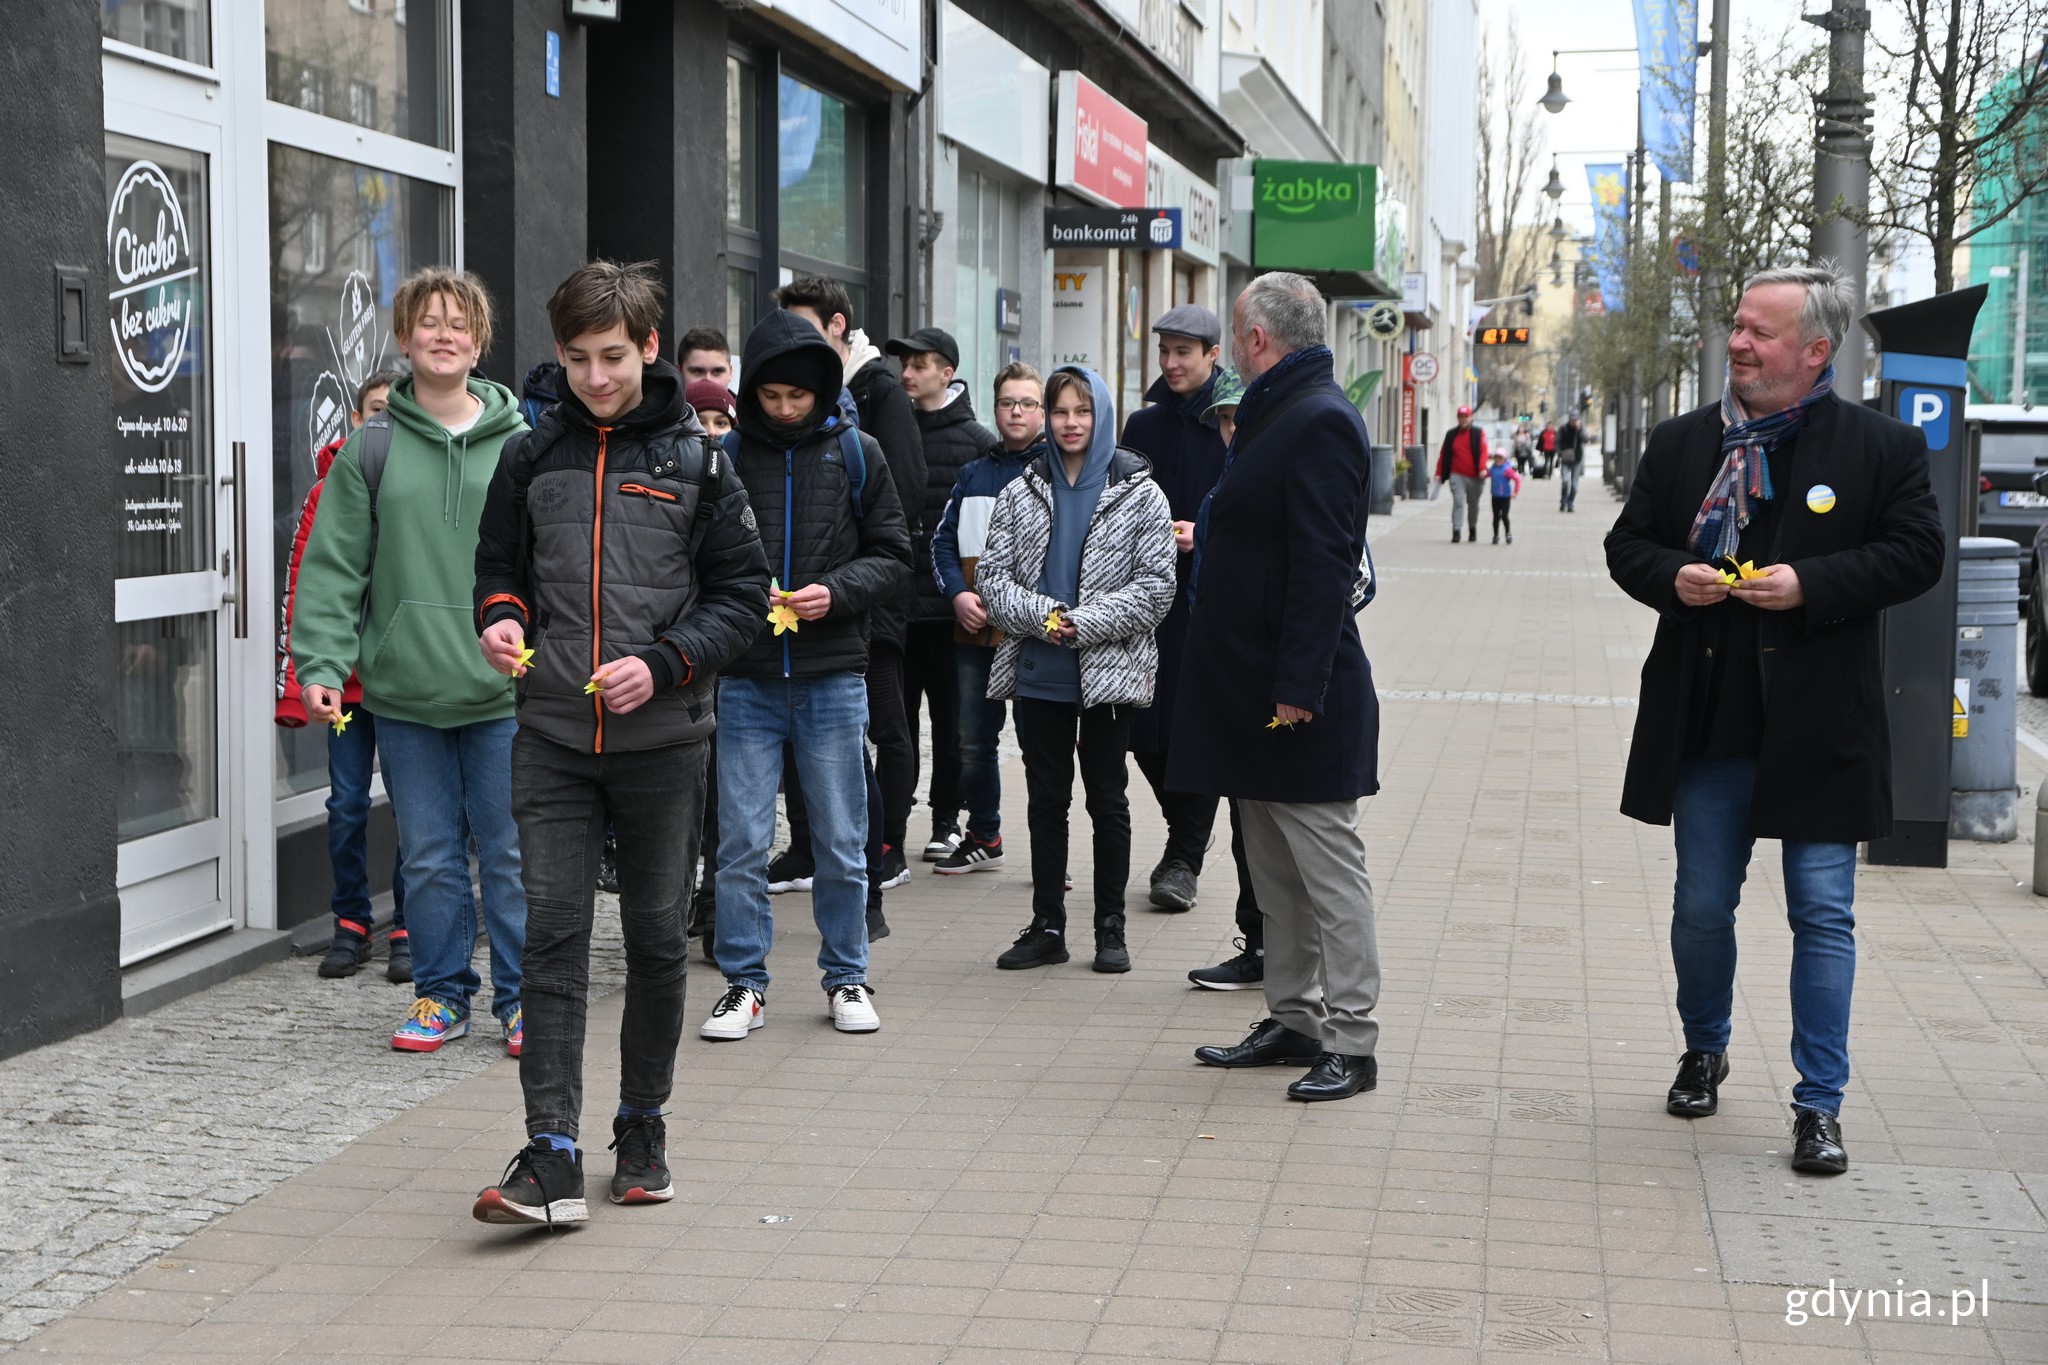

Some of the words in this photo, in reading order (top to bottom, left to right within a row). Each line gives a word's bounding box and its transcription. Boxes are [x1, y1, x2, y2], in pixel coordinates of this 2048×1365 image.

[1262, 176, 1352, 201] żabka
[1121, 214, 1138, 223] 24h
[1053, 224, 1137, 241] bankomat
[115, 209, 177, 284] Ciacho
[1054, 273, 1087, 291] TY
[121, 298, 142, 340] bez
[146, 285, 181, 332] cukru
[343, 322, 362, 356] GLUTEN
[361, 303, 374, 329] FREE
[1912, 393, 1943, 427] P
[163, 417, 171, 432] 10
[178, 417, 187, 432] 20
[313, 427, 333, 458] SUGAR
[330, 404, 344, 430] FREE
[159, 459, 167, 474] 10
[174, 459, 182, 474] 19
